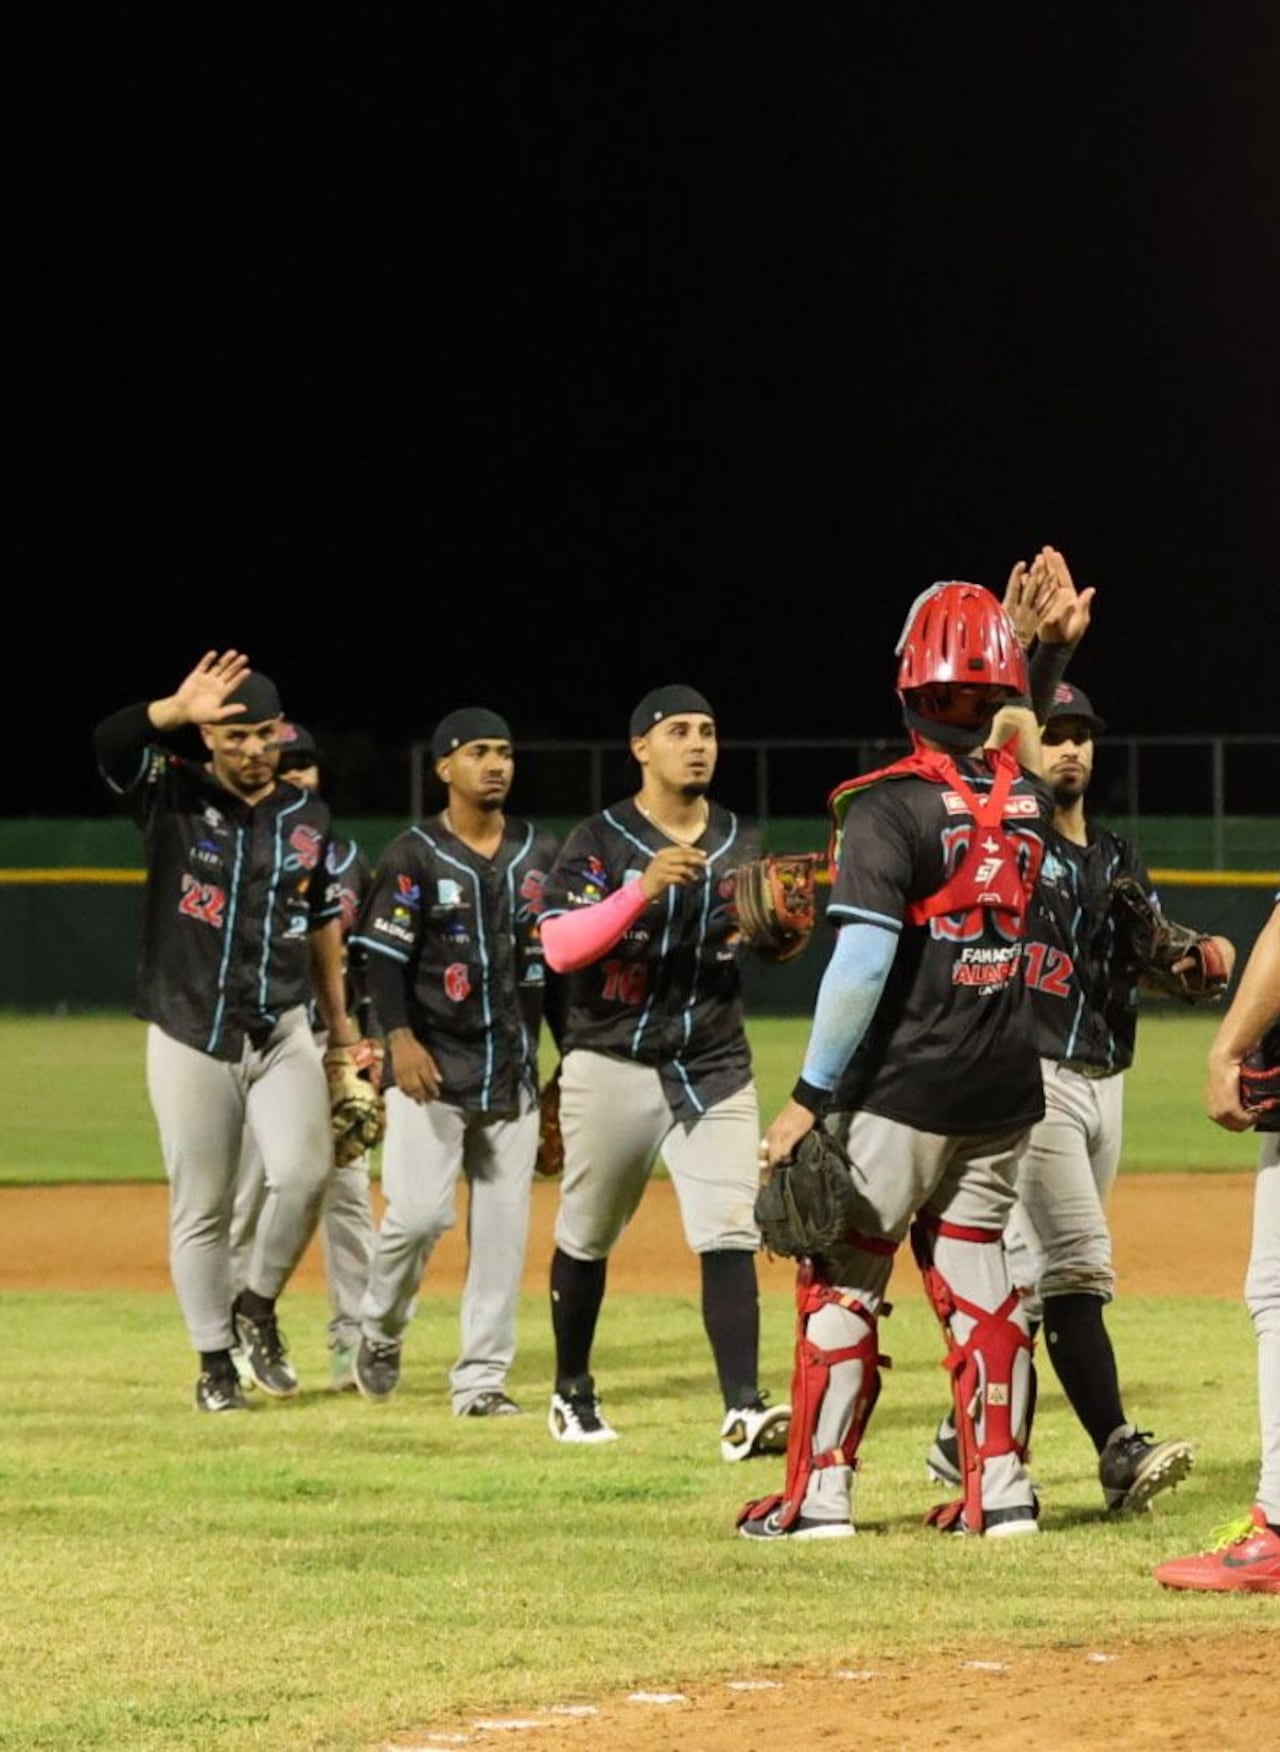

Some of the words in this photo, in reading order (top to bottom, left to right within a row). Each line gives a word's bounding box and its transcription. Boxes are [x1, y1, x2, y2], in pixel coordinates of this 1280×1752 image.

[178, 872, 226, 929] 22
[444, 962, 471, 1003] 6
[1023, 940, 1074, 998] 12
